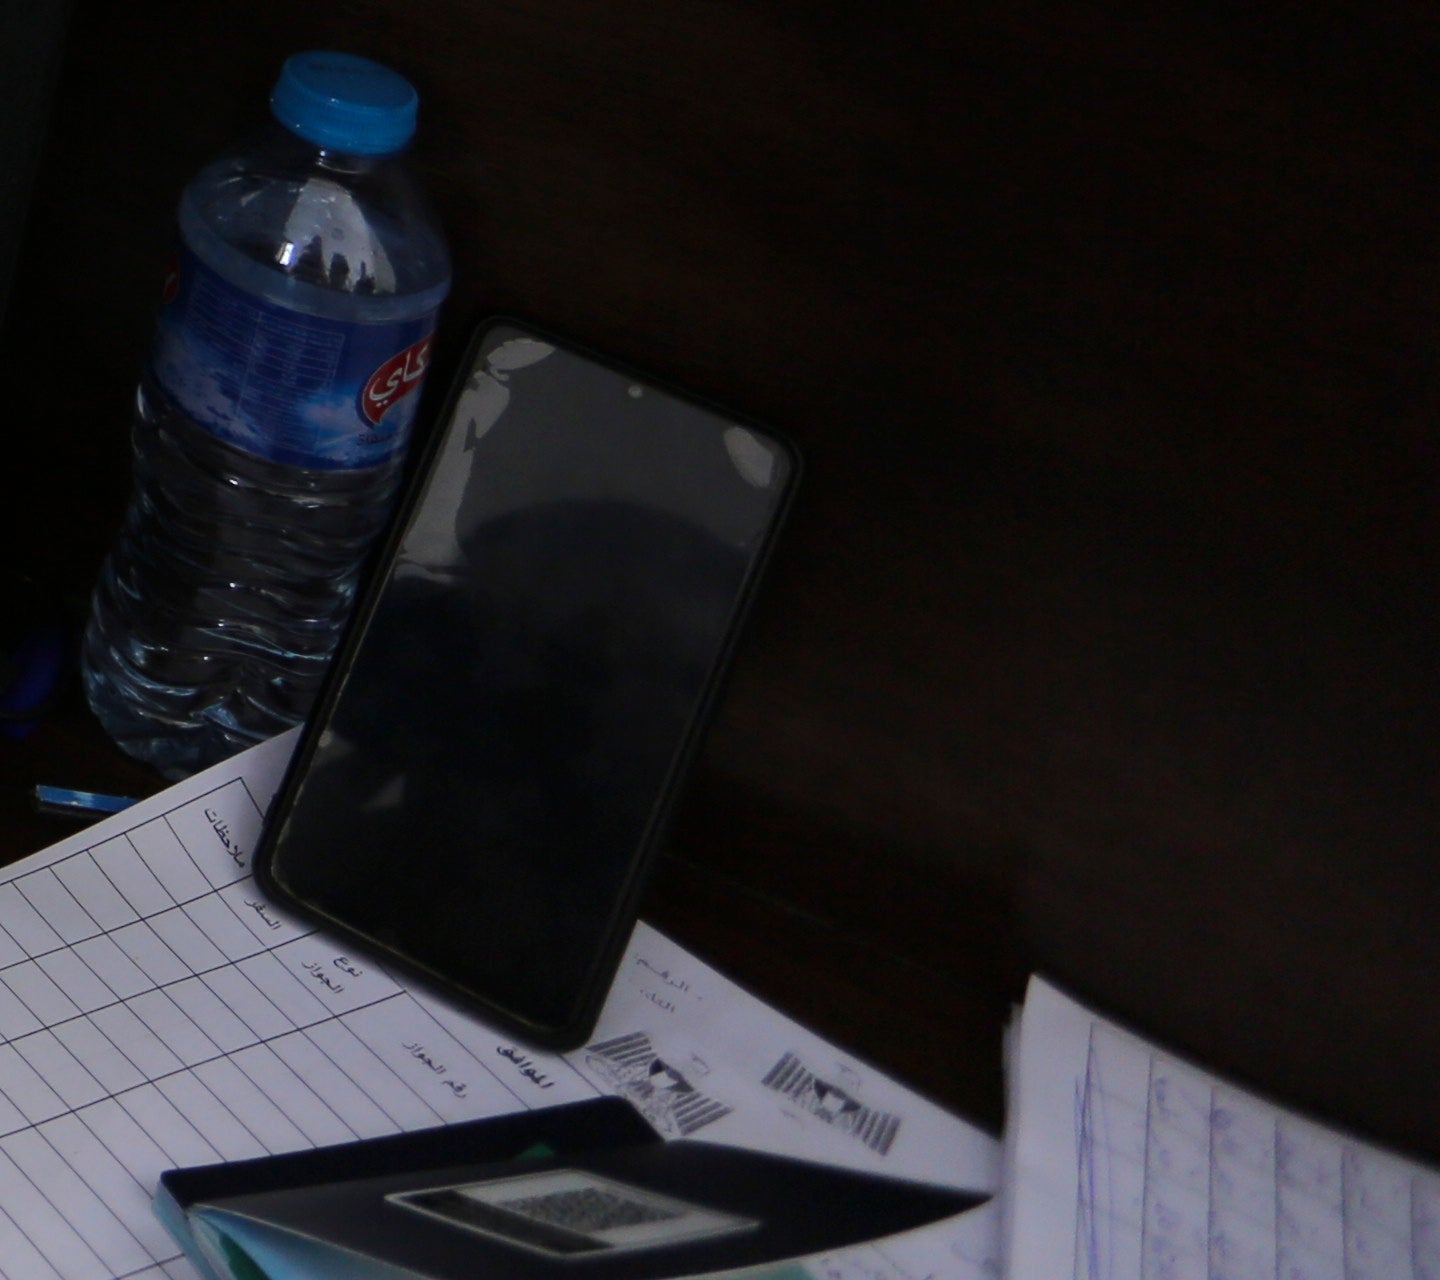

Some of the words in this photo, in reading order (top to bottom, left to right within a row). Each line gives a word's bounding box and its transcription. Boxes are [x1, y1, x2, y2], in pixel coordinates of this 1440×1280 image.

[204, 807, 246, 869] ملاحظات
[244, 896, 282, 931] السفر
[301, 959, 344, 994] الجواز
[332, 954, 363, 979] نوع
[402, 1040, 447, 1076] الجواز
[496, 1044, 555, 1090] الموافق
[443, 1077, 468, 1100] رقم
